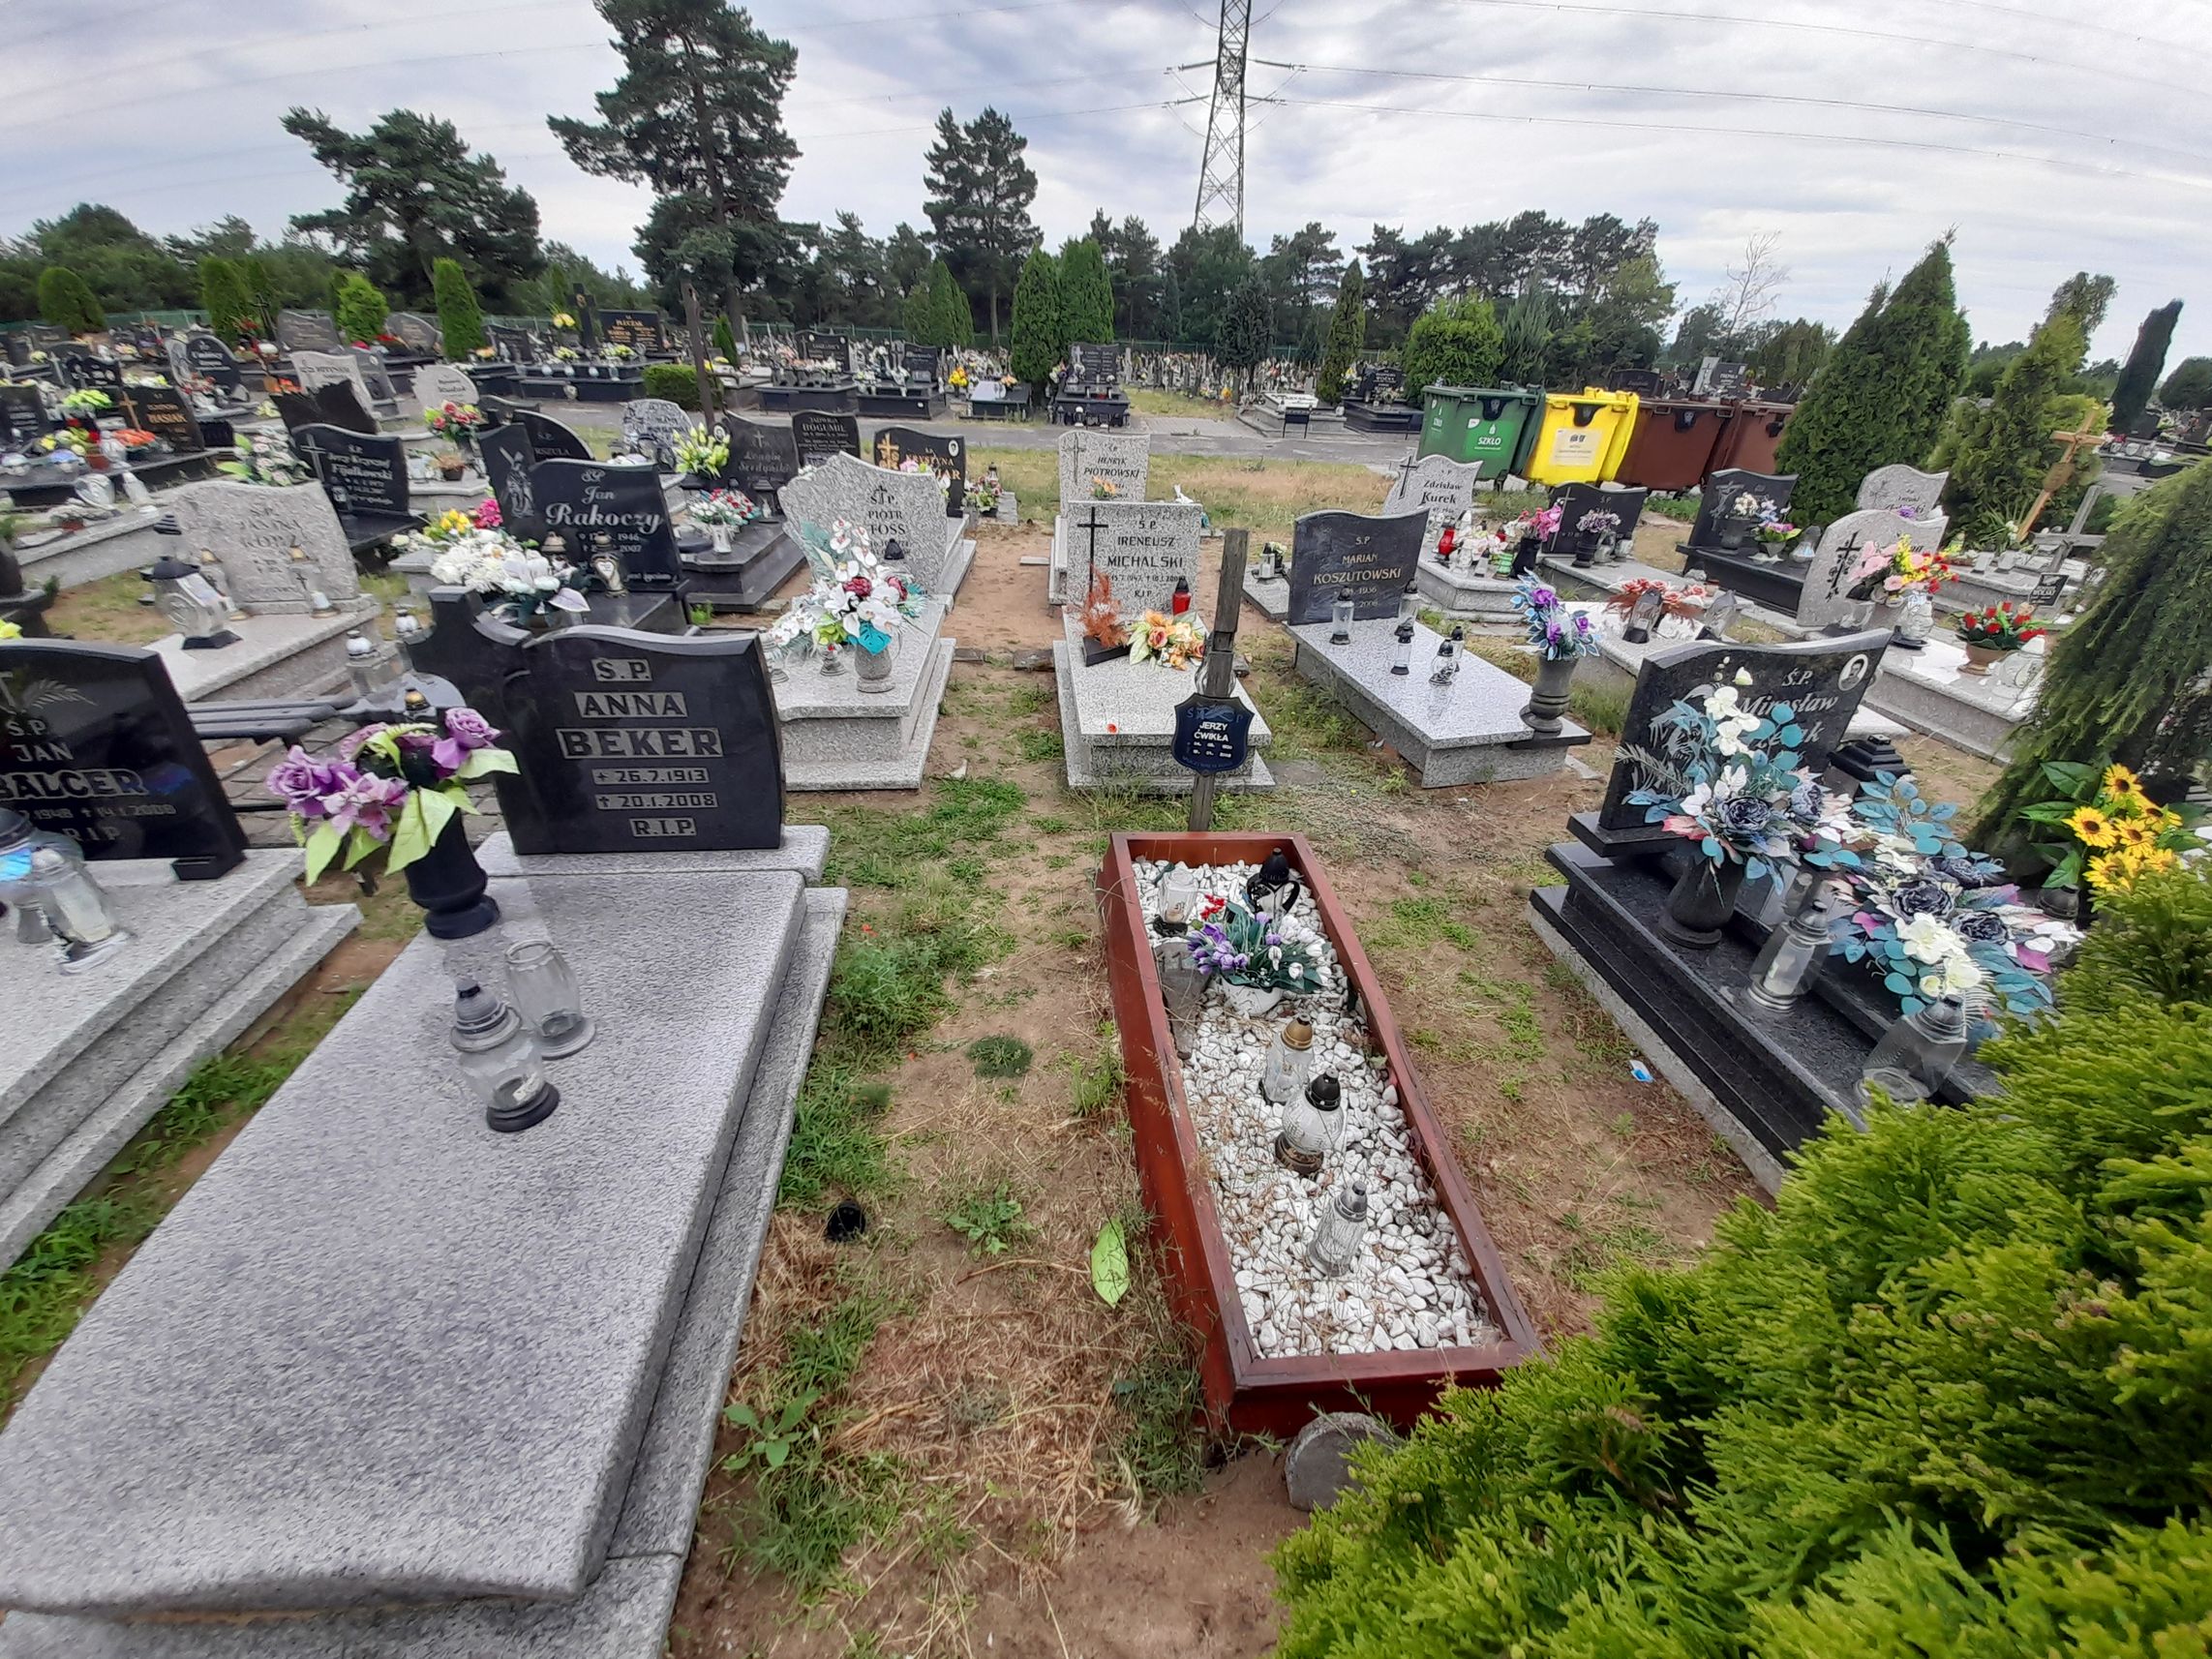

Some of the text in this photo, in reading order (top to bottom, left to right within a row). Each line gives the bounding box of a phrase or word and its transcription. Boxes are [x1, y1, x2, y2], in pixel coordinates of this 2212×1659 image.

[1478, 437, 1501, 445] SZKŁO
[533, 447, 571, 456] RSZULA
[1098, 457, 1127, 466] HENRYK
[1083, 467, 1140, 478] PIOTROWSKI
[582, 486, 615, 504] Jan
[1420, 492, 1456, 506] Kurek
[546, 503, 664, 534] Rakoczy
[868, 511, 903, 520] PIOTR
[868, 524, 907, 534] FOSS
[1117, 535, 1175, 547] IRENEUSZ
[1107, 556, 1183, 568] MICHALSKI
[1342, 553, 1379, 564] MARIAN
[1313, 568, 1402, 585] KOSZUTOWSKI
[584, 694, 684, 716] ANNA
[1199, 721, 1228, 732] JERZY
[1194, 729, 1229, 742] ĆWIKŁA
[560, 730, 722, 757] BEKER
[11, 742, 75, 762] JAN
[621, 795, 715, 808] 20.1.2008
[633, 820, 696, 835] R.I.P.
